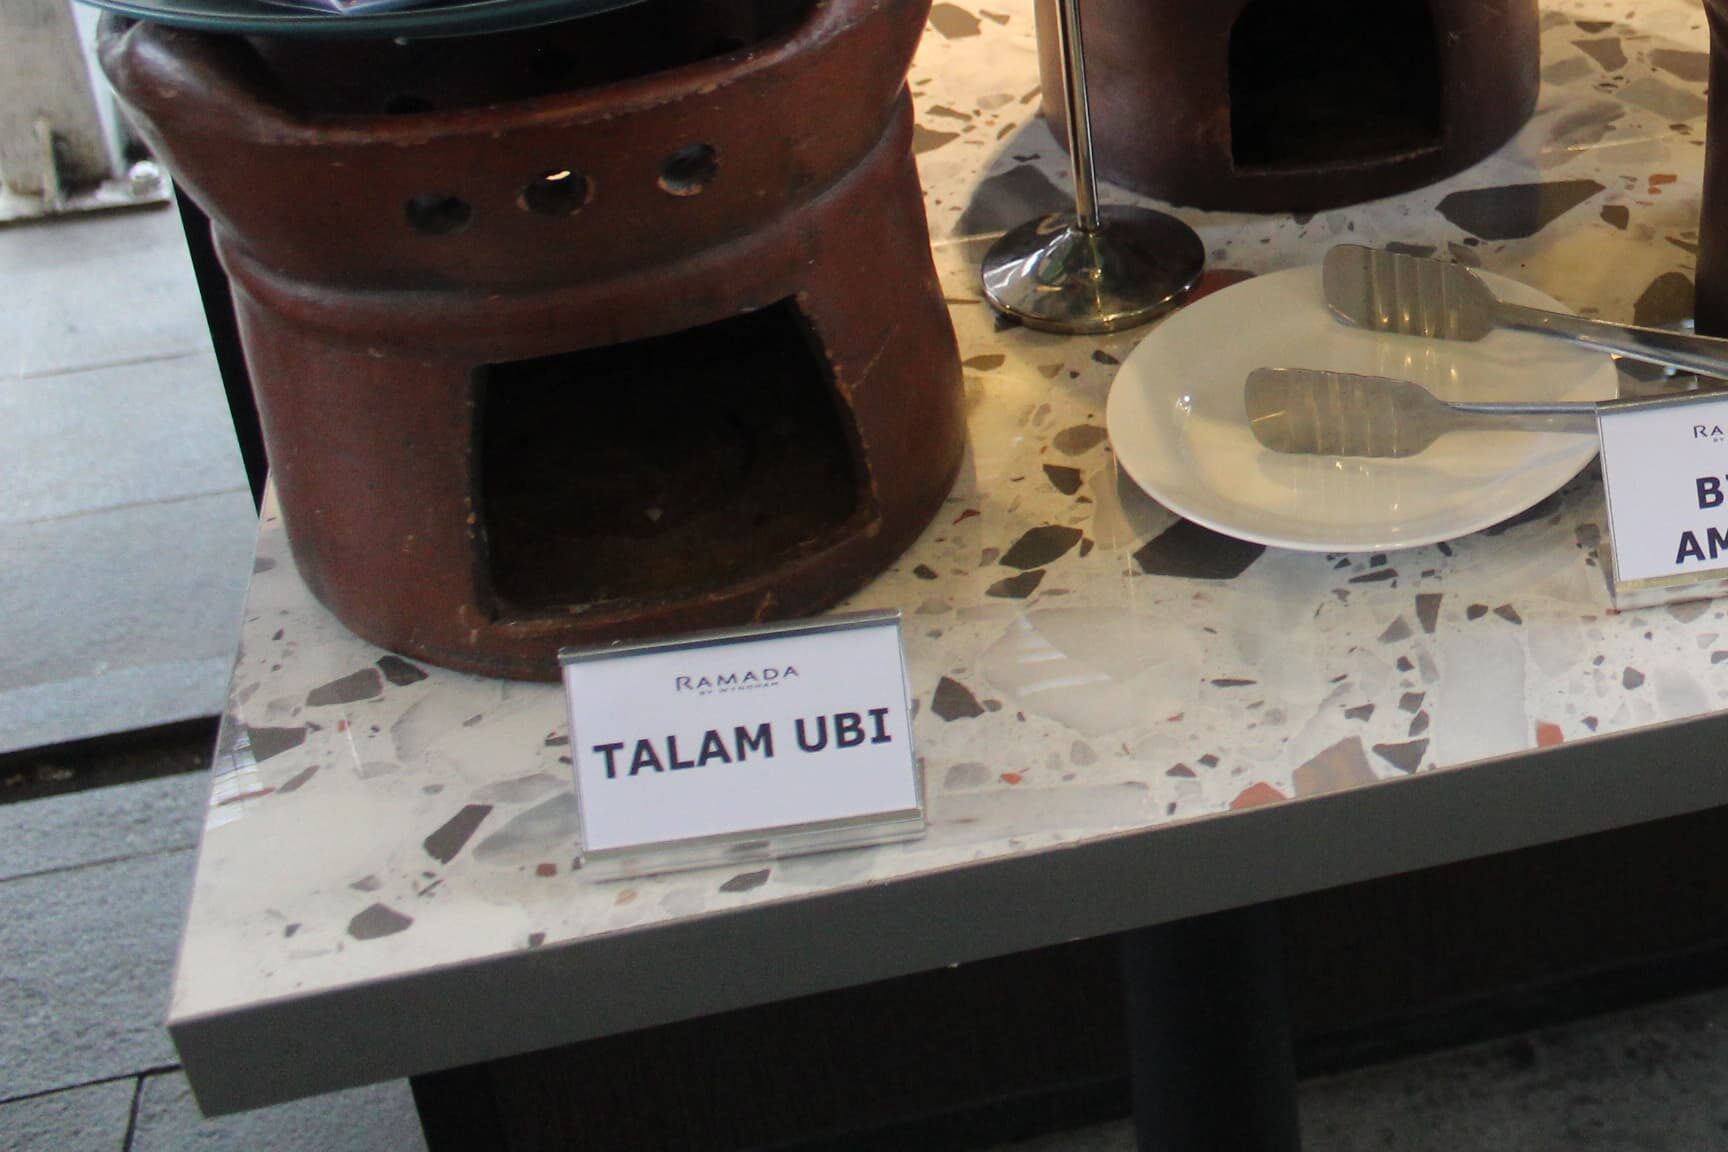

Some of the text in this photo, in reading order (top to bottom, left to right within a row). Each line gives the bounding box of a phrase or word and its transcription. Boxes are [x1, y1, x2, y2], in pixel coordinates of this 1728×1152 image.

[675, 665, 799, 692] RAMADA
[594, 707, 892, 779] TALAM UBI
